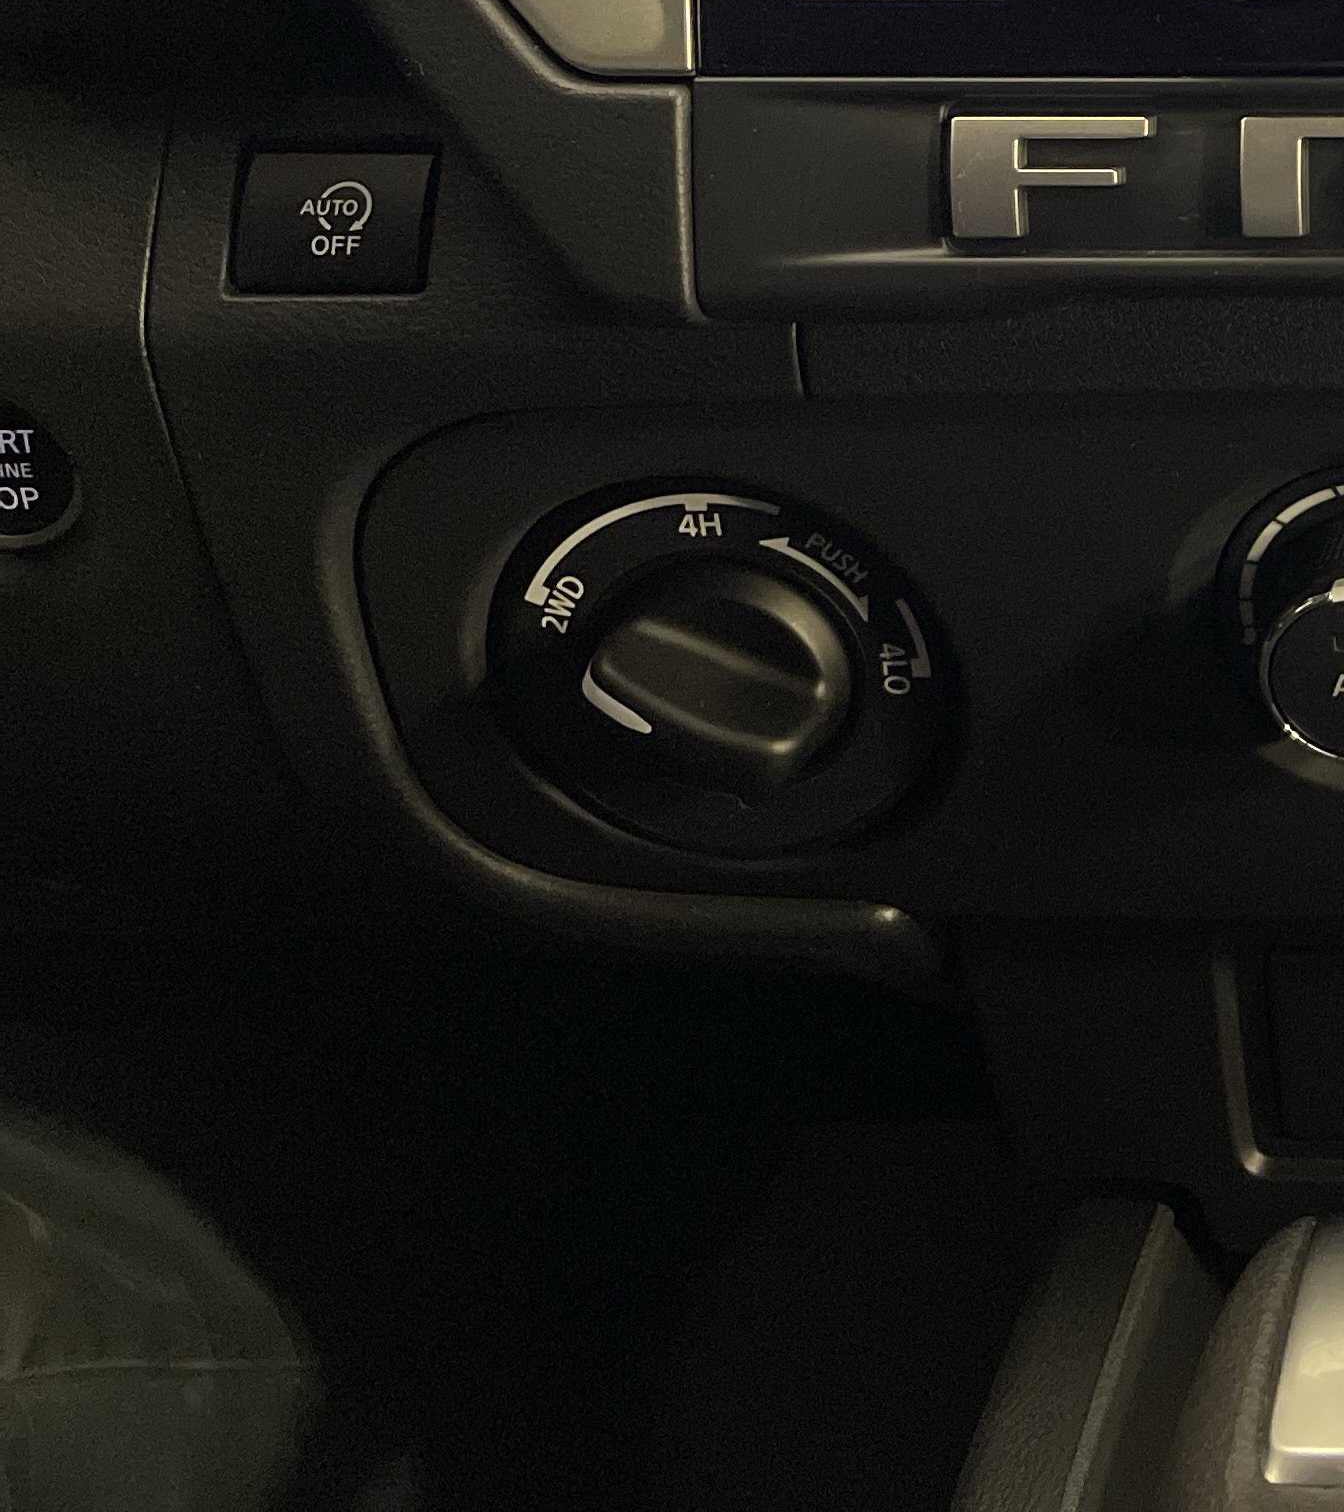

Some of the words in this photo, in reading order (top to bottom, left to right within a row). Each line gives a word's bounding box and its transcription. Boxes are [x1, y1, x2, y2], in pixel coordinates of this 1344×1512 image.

[300, 198, 359, 217] AUTO
[310, 235, 362, 256] OFF
[0, 429, 34, 454] RT
[678, 513, 723, 538] 4H
[805, 531, 869, 585] PUSH
[541, 575, 585, 635] 2WD
[880, 642, 911, 696] 4LO
